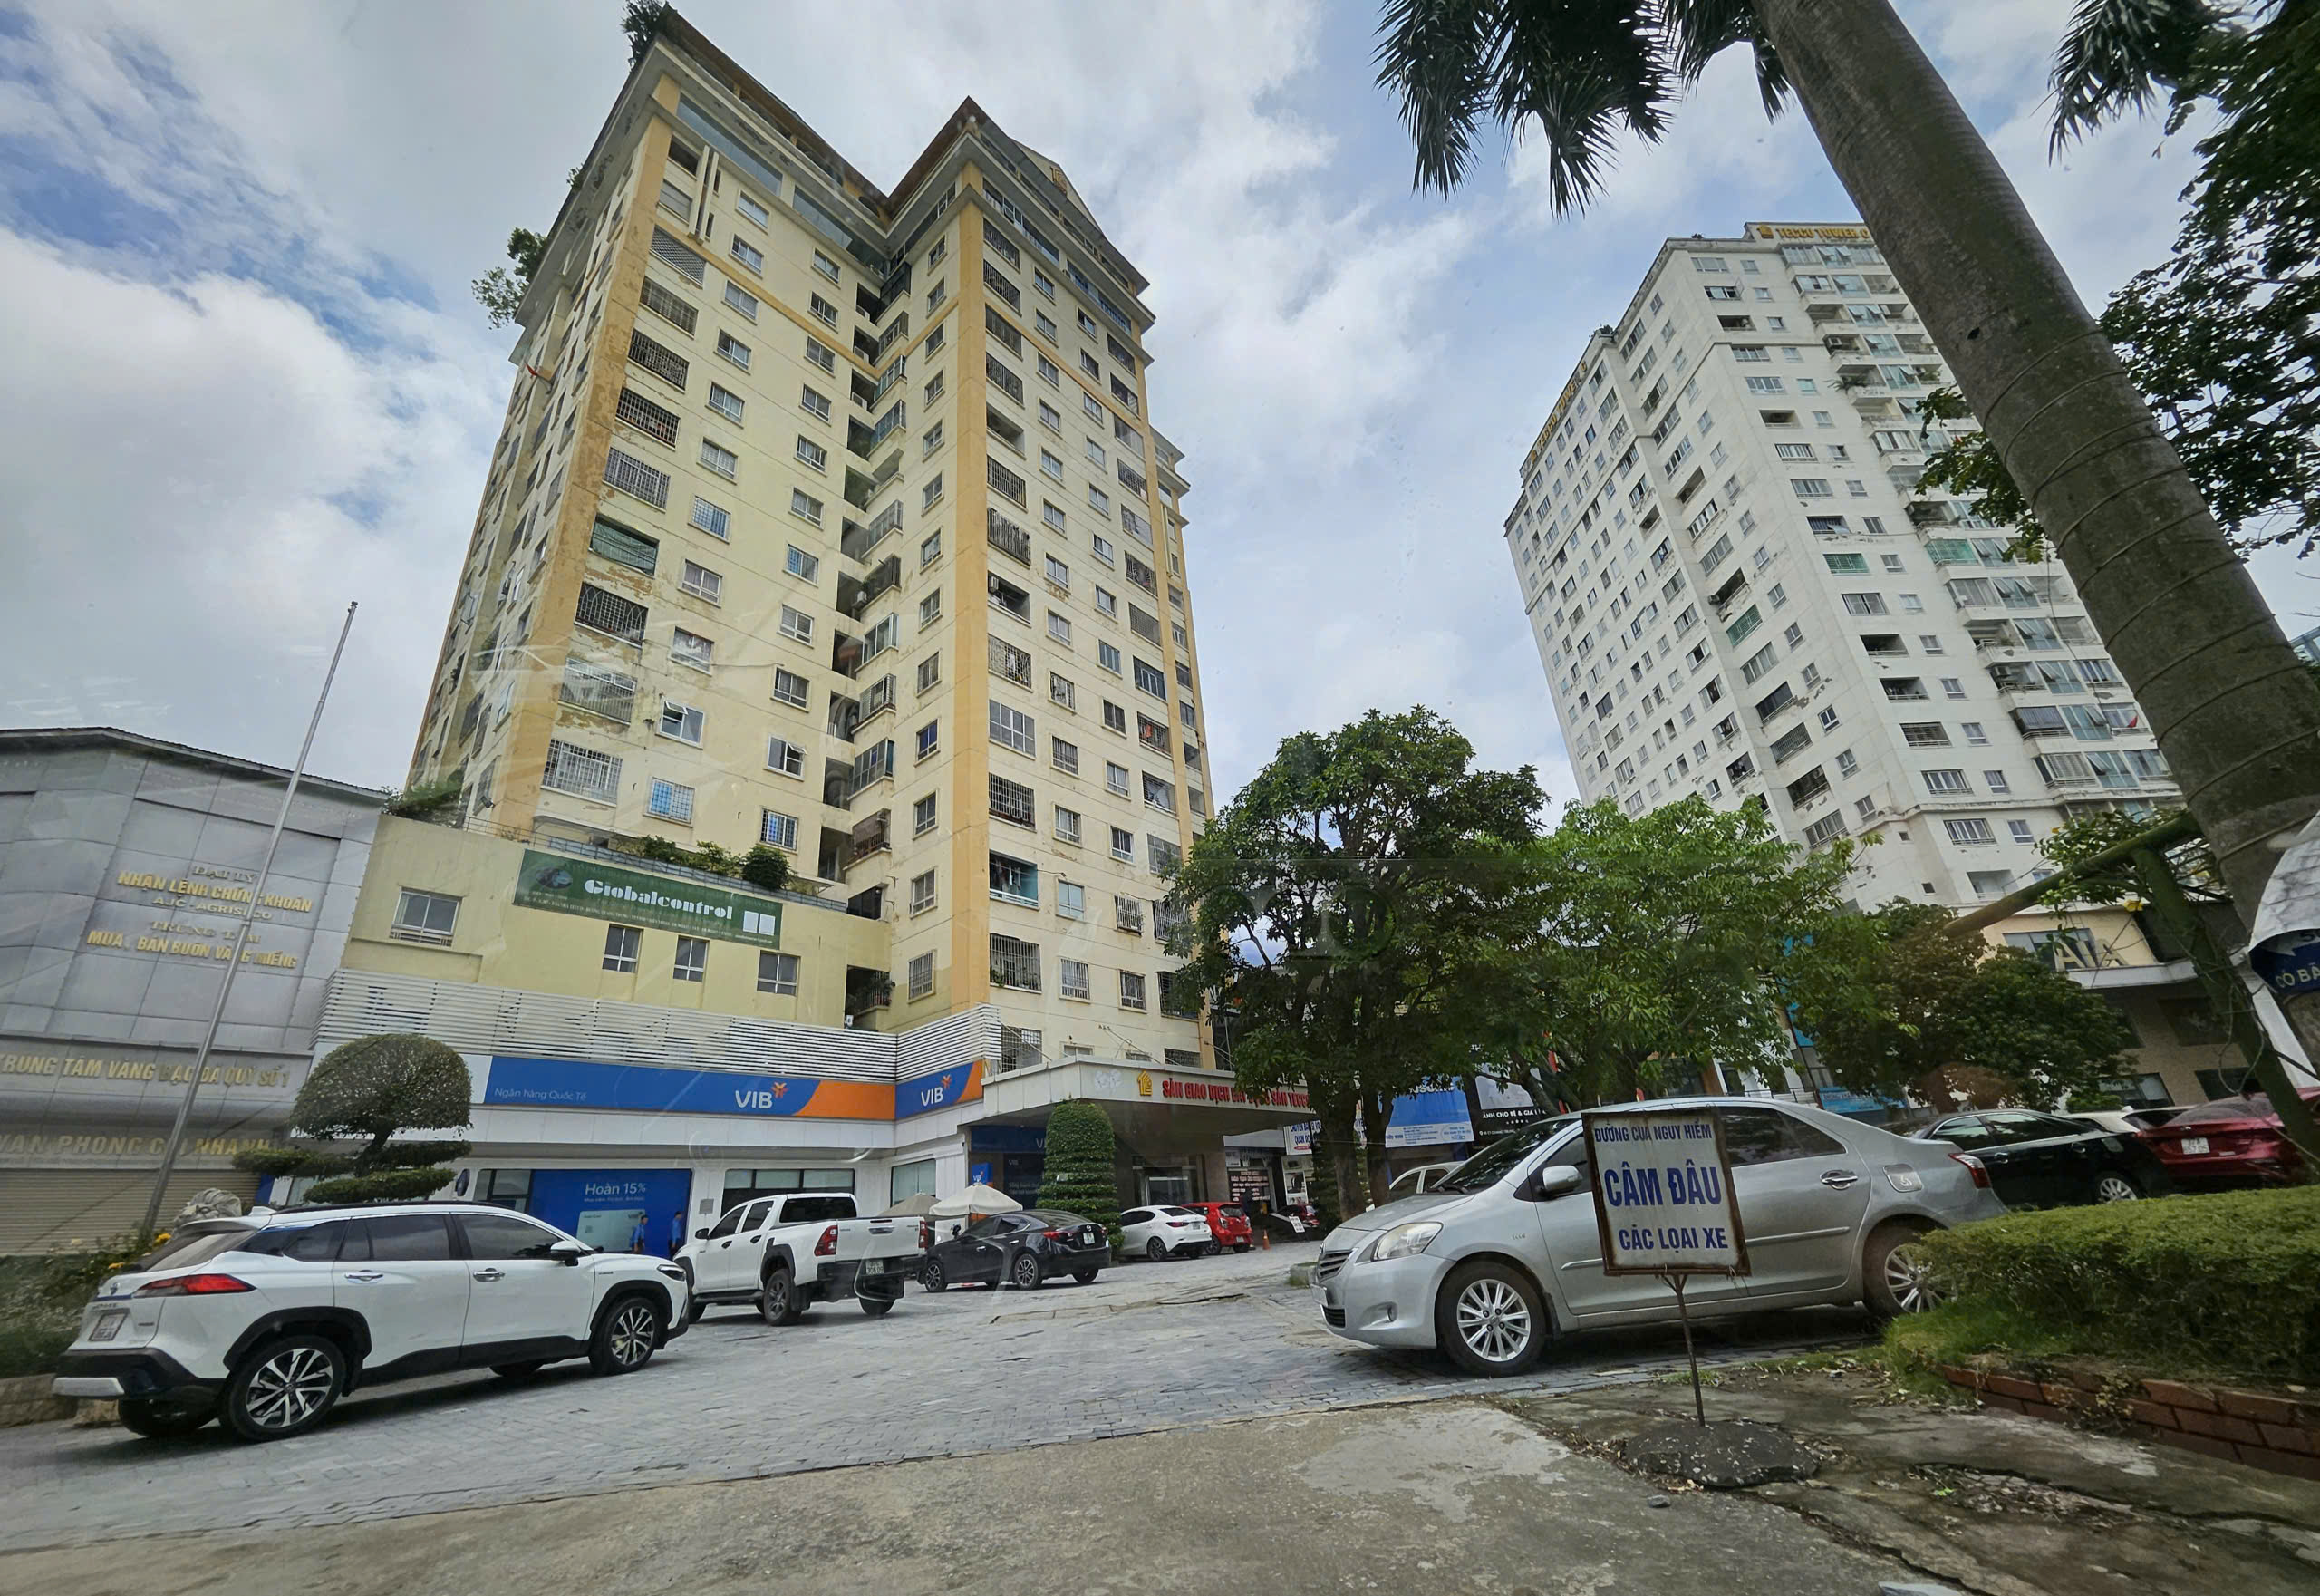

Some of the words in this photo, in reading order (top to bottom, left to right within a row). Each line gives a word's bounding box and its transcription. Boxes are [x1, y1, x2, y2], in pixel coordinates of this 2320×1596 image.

[210, 885, 261, 905] CHỨN
[195, 902, 273, 920] AGRISCO
[215, 943, 251, 962] VÀG
[735, 1090, 774, 1109] VIB
[921, 1087, 943, 1107] VIB
[1653, 1124, 1682, 1140] NGUY
[585, 1182, 621, 1195] Hoàn
[623, 1182, 646, 1195] 15%
[1702, 1227, 1728, 1249] XE
